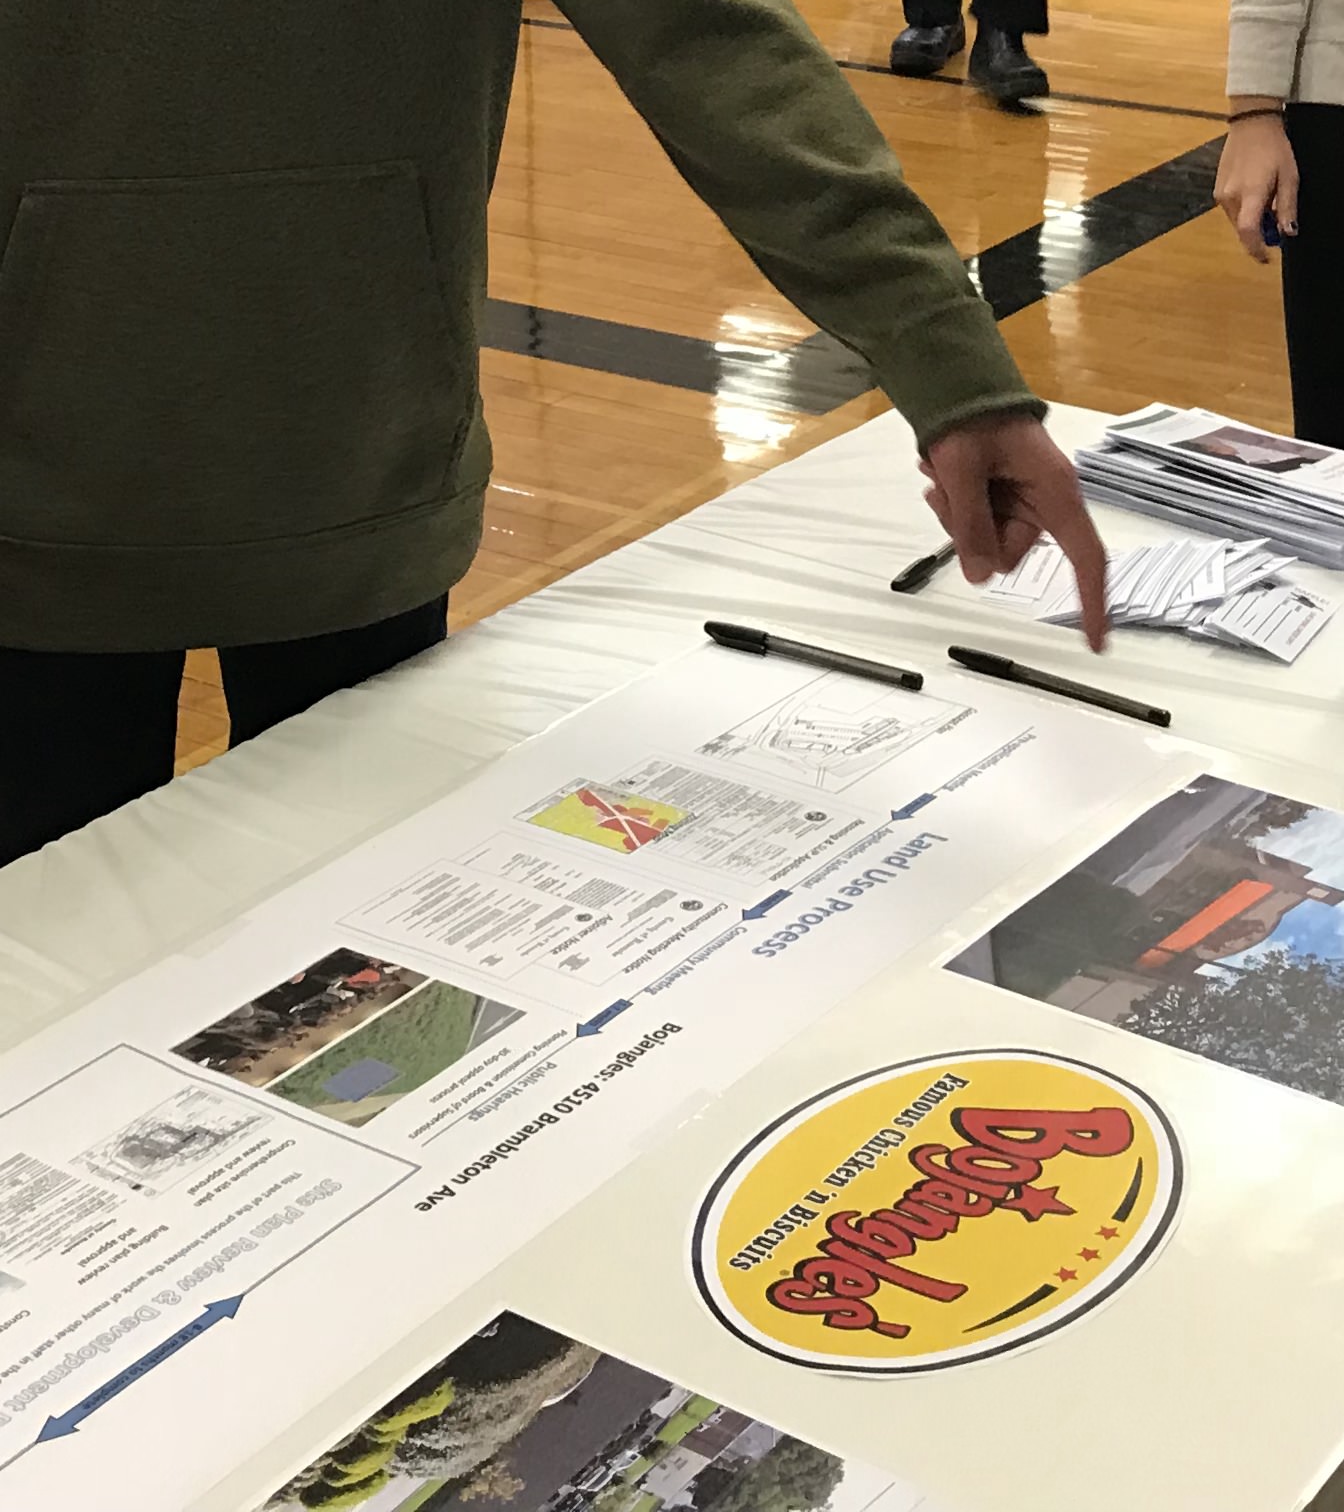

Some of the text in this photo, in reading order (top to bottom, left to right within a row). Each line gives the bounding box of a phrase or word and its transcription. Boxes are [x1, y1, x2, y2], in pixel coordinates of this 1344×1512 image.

[880, 828, 950, 871] Land
[836, 864, 897, 902] Use
[748, 894, 855, 963] Process
[464, 1061, 558, 1123] Public Hearings
[894, 1073, 968, 1130] Famous
[412, 1020, 685, 1214] Bojangles: 4510 Brambleton Ave
[836, 1128, 905, 1188] Chicken
[257, 1182, 284, 1198] part
[277, 1170, 303, 1186] This
[248, 1196, 266, 1206] of
[291, 1177, 345, 1209] Site
[232, 1203, 254, 1216] the
[247, 1204, 306, 1241] Plan
[196, 1213, 237, 1240] process
[729, 1197, 819, 1271] Biscuits
[160, 1237, 203, 1266] involves
[172, 1235, 261, 1293] Review
[144, 1263, 166, 1277] the
[107, 1292, 125, 1302] of
[118, 1275, 149, 1294] work
[150, 1288, 186, 1308] &
[78, 1299, 112, 1321] many
[52, 1319, 85, 1340] other
[15, 1355, 34, 1365] in
[26, 1338, 58, 1358] staff
